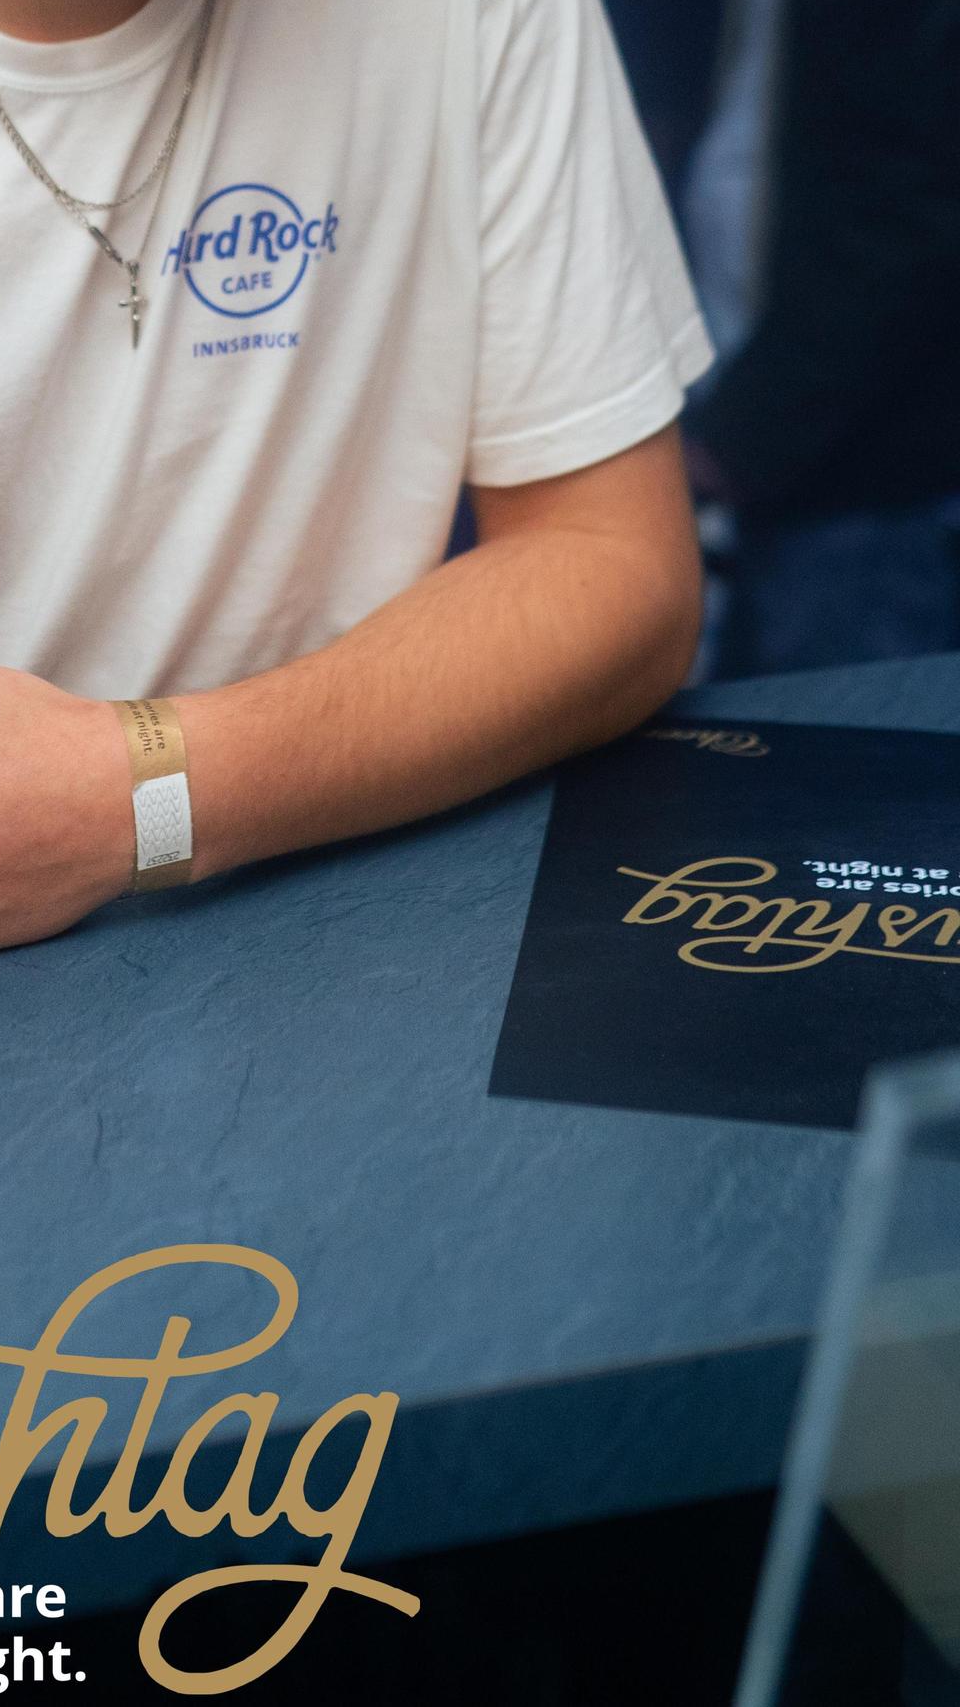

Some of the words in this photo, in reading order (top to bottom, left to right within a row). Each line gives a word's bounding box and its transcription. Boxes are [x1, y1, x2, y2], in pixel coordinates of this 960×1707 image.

[249, 202, 339, 263] Rock
[220, 271, 273, 295] CAFE
[192, 332, 300, 358] INNSBRUCK
[137, 722, 153, 757] night.
[154, 729, 166, 750] are
[802, 860, 903, 878] night.
[912, 867, 950, 880] at
[815, 877, 874, 891] are
